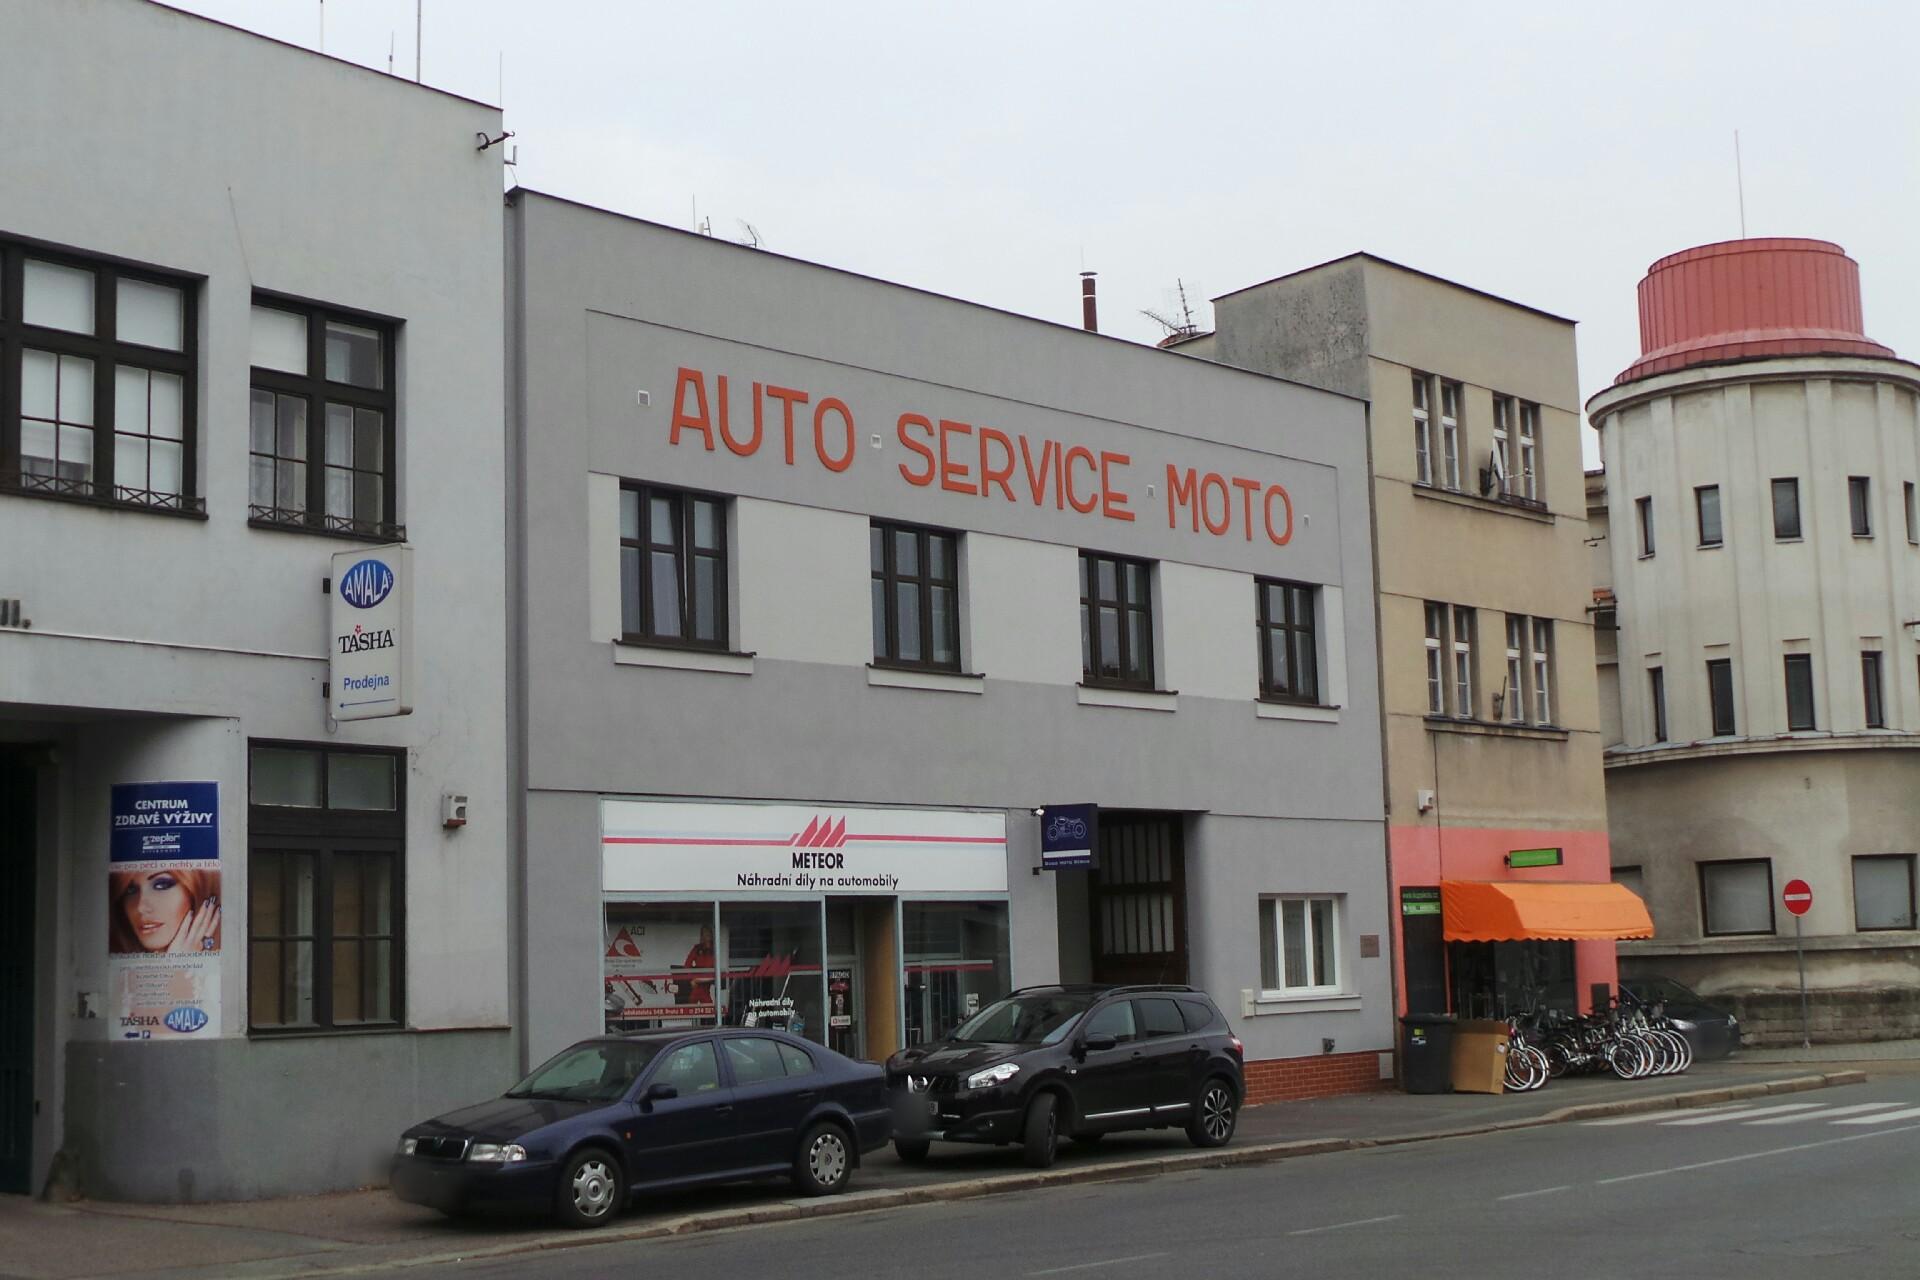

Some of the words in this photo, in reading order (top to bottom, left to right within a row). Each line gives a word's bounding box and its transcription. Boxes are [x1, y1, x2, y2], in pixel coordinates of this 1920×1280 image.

[669, 367, 855, 473] AUTO
[897, 412, 1136, 522] SERVICE
[1166, 463, 1294, 546] MOTO
[345, 562, 390, 606] AMALA
[338, 629, 394, 654] TASHA
[343, 673, 390, 691] Prodejna
[135, 799, 188, 810] CENTRUM
[115, 811, 160, 826] ZDRAVÉ
[163, 810, 213, 824] VÝŽIVY
[792, 852, 844, 869] METEOR
[737, 872, 792, 886] Náhradní
[795, 873, 816, 890] díly
[819, 878, 834, 886] na
[837, 873, 899, 890] automobily
[749, 997, 780, 1007] Náhradní
[120, 1016, 160, 1027] TASHA
[168, 1008, 205, 1030] AMALA
[758, 1008, 796, 1018] automobily
